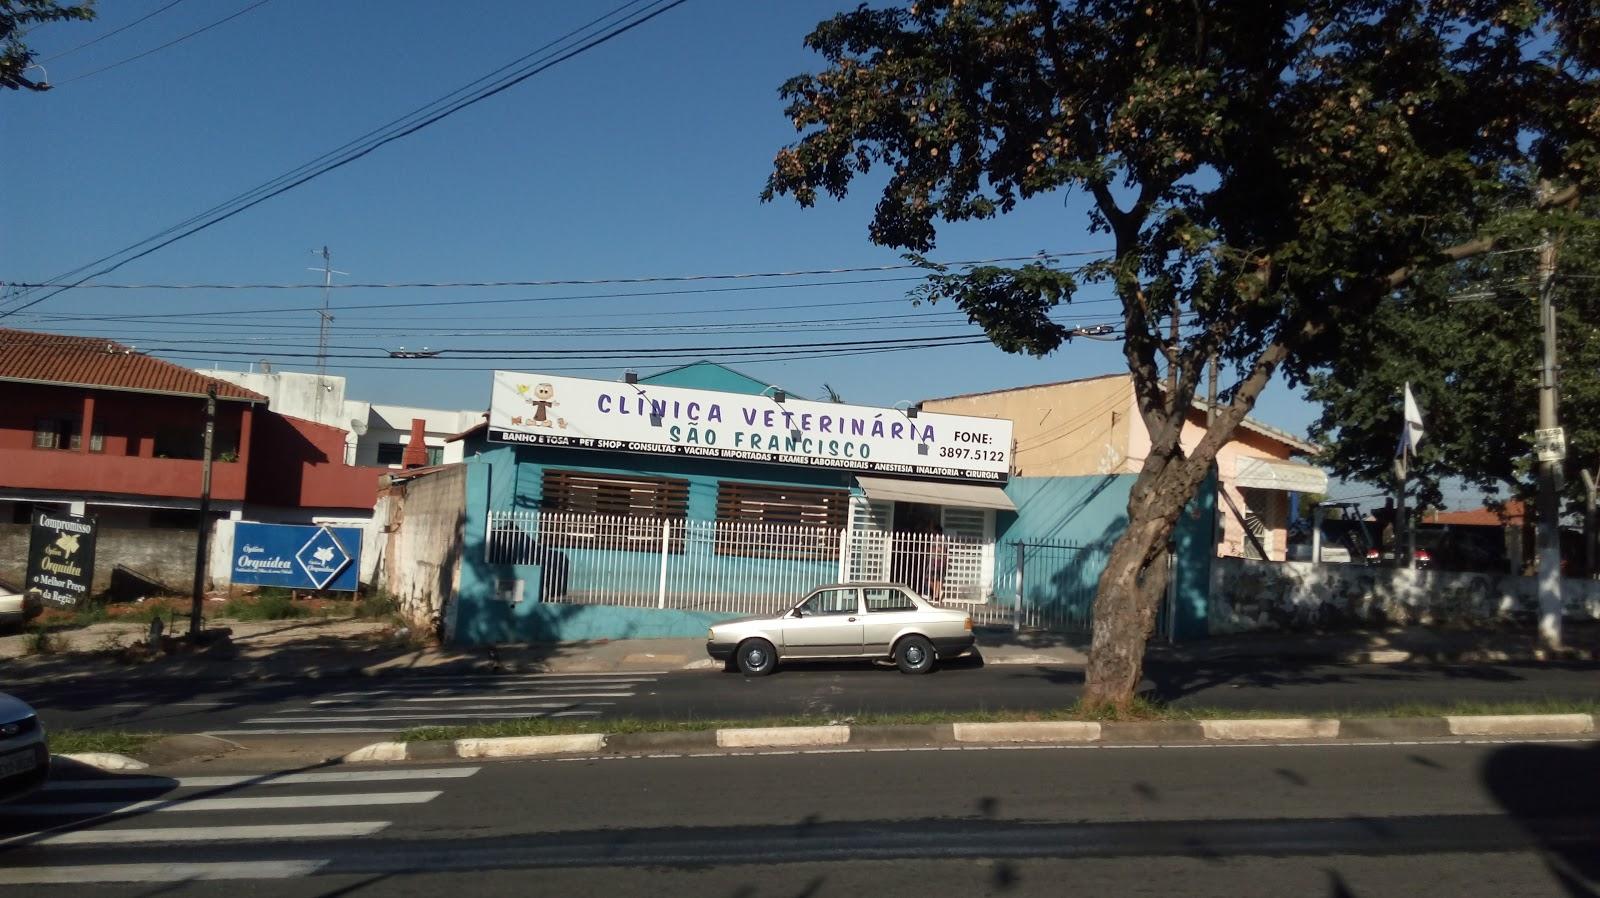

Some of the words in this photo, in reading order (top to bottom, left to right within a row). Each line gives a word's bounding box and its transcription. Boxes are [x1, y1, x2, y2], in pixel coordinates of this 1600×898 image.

[597, 389, 722, 423] CLÍNICA
[742, 403, 935, 443] VETERINÁRIA
[669, 422, 717, 446] SÃO
[734, 431, 870, 459] FRANCISCO
[954, 431, 993, 445] FONE:
[502, 432, 537, 443] BANHO
[538, 435, 544, 443] E
[546, 436, 569, 446] TOSA
[579, 438, 595, 447] PET
[597, 440, 621, 449] SHOP
[628, 442, 677, 454] CONSULTAS
[683, 446, 720, 457] VACINAS
[720, 449, 772, 461] IMPORTADAS
[778, 454, 809, 465] EXAMES
[810, 457, 869, 470] LABORATORIAIS
[874, 462, 914, 473] ANESTESIA
[965, 470, 1000, 480] CIRURGIA
[939, 446, 1005, 462] 3897.5122
[40, 514, 91, 533] Compromisso
[40, 574, 66, 588] Melhor
[66, 580, 86, 593] Preço
[42, 589, 52, 600] da
